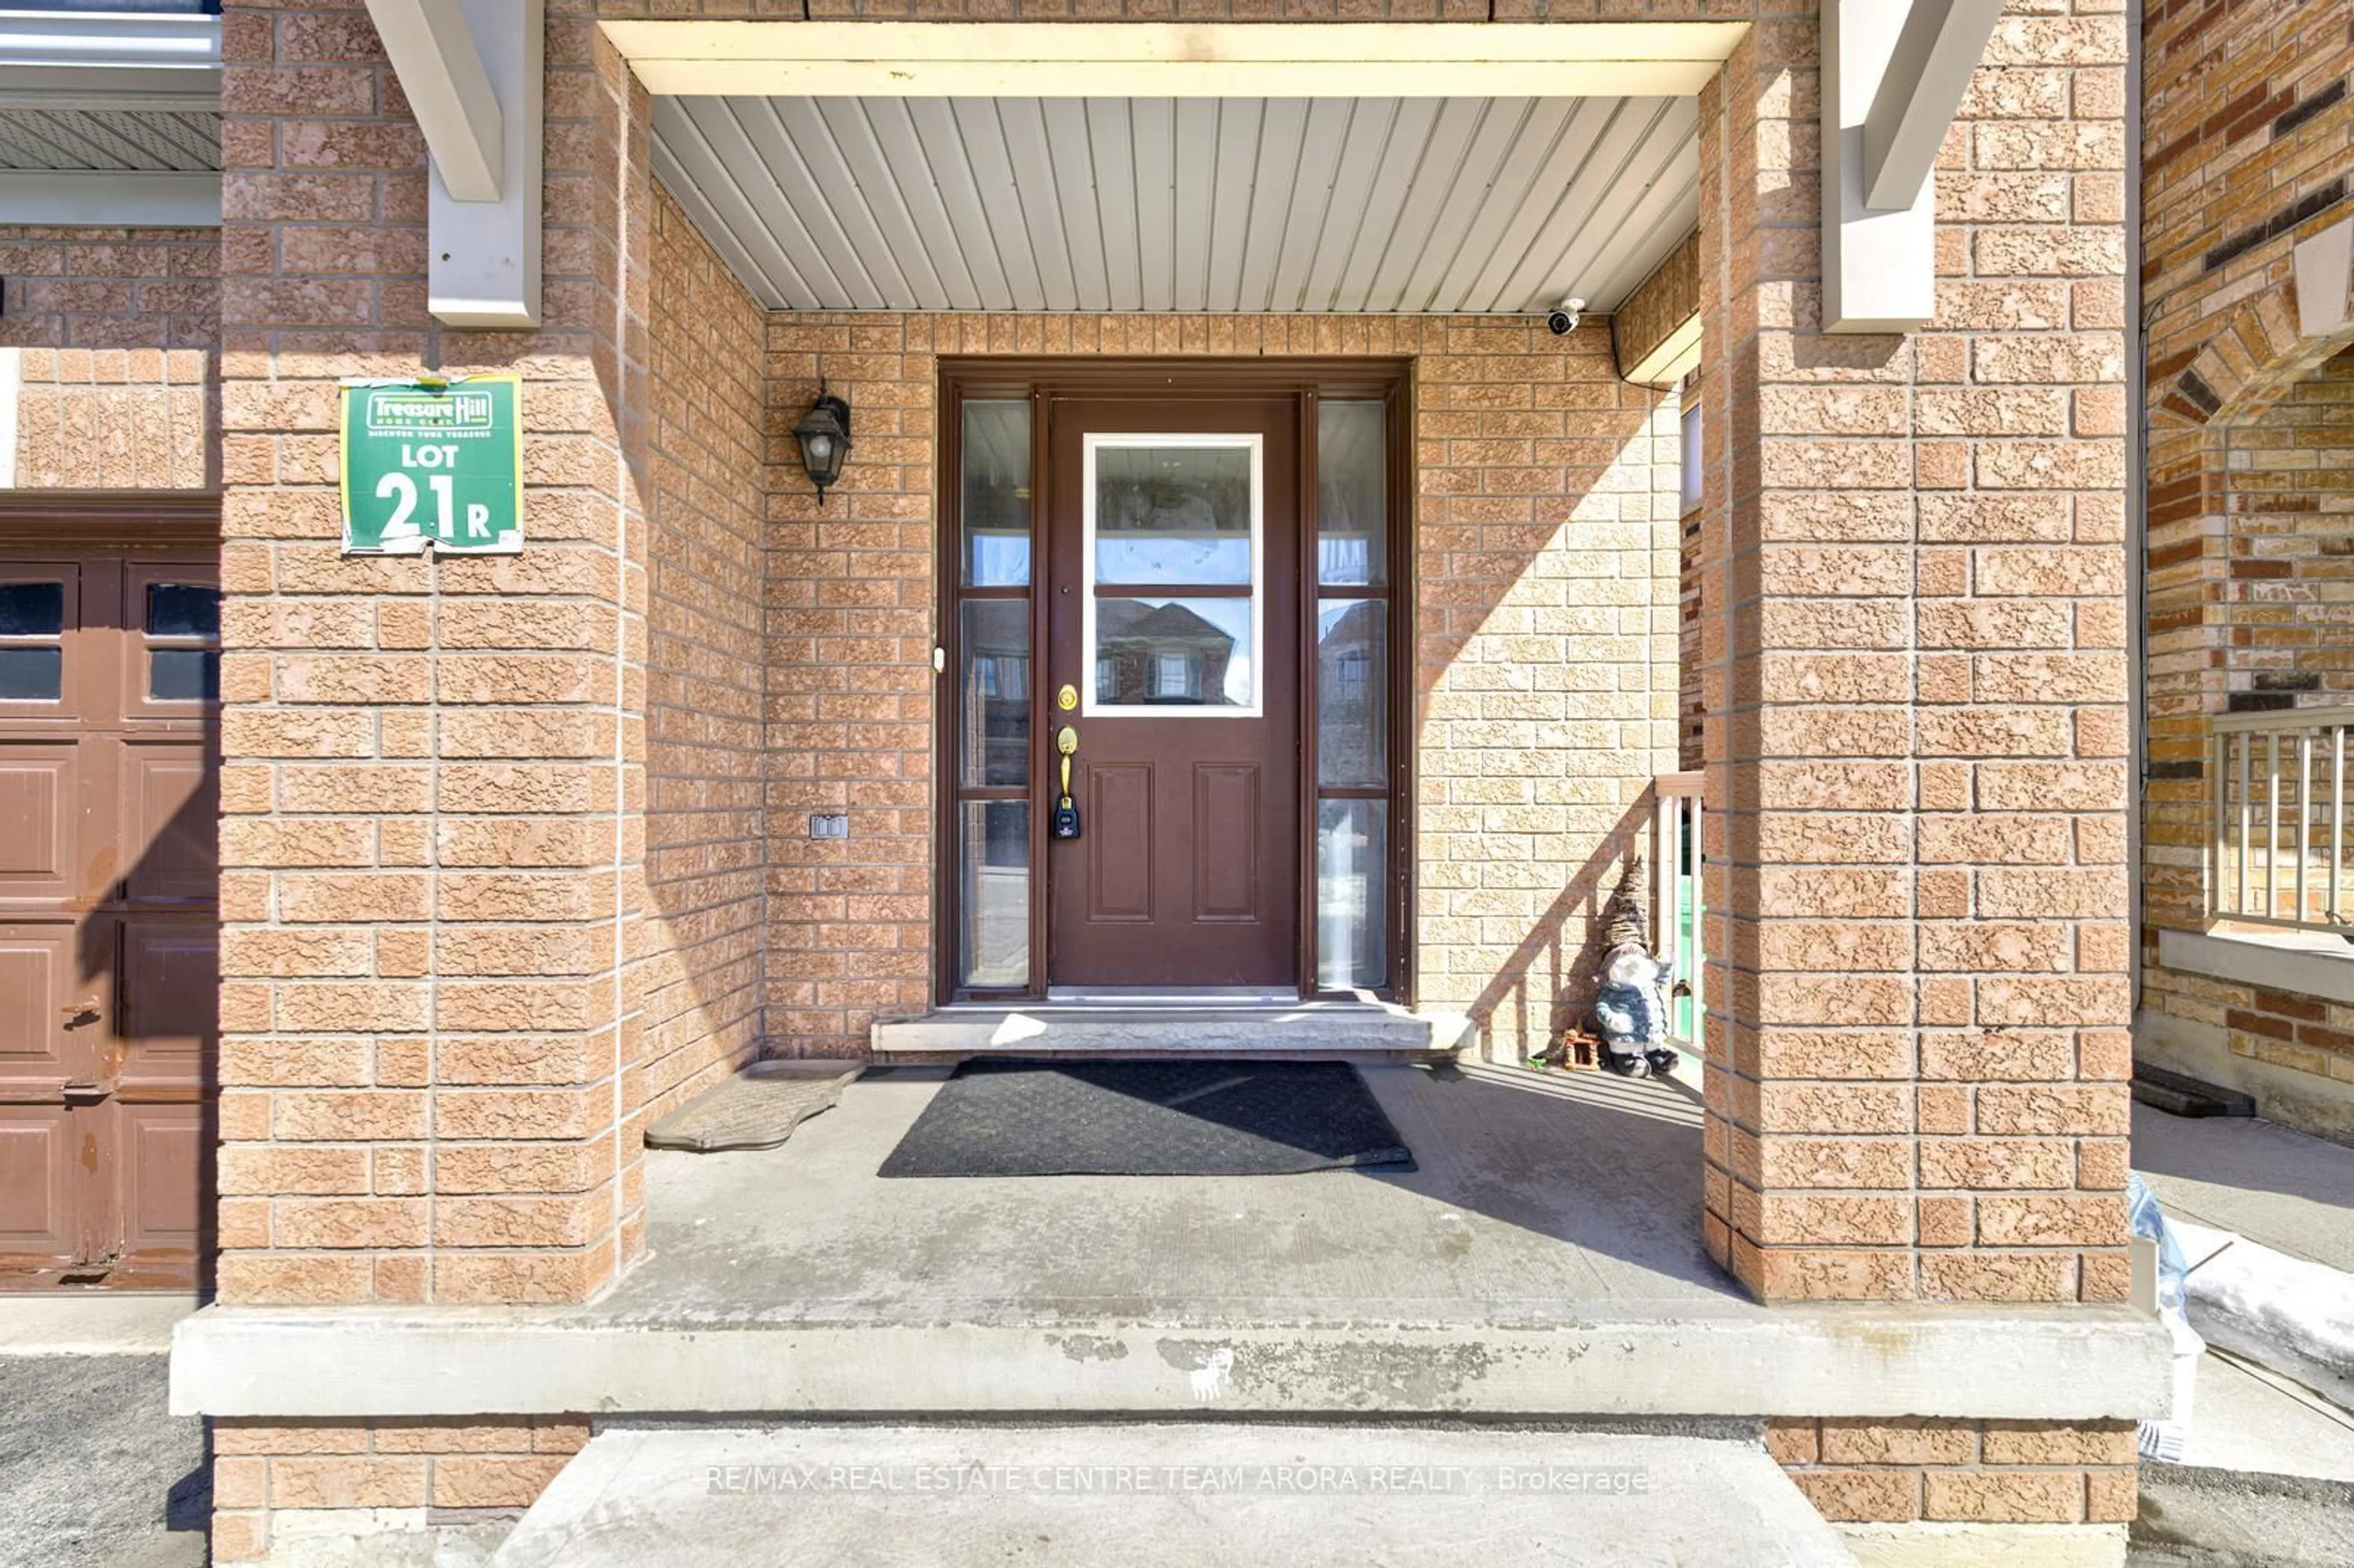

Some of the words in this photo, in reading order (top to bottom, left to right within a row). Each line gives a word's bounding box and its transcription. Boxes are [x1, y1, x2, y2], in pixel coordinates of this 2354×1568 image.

[374, 397, 454, 417] Treasure
[455, 397, 487, 424] Hill
[402, 444, 459, 468] LOT
[376, 471, 455, 538] 21
[467, 503, 492, 538] R
